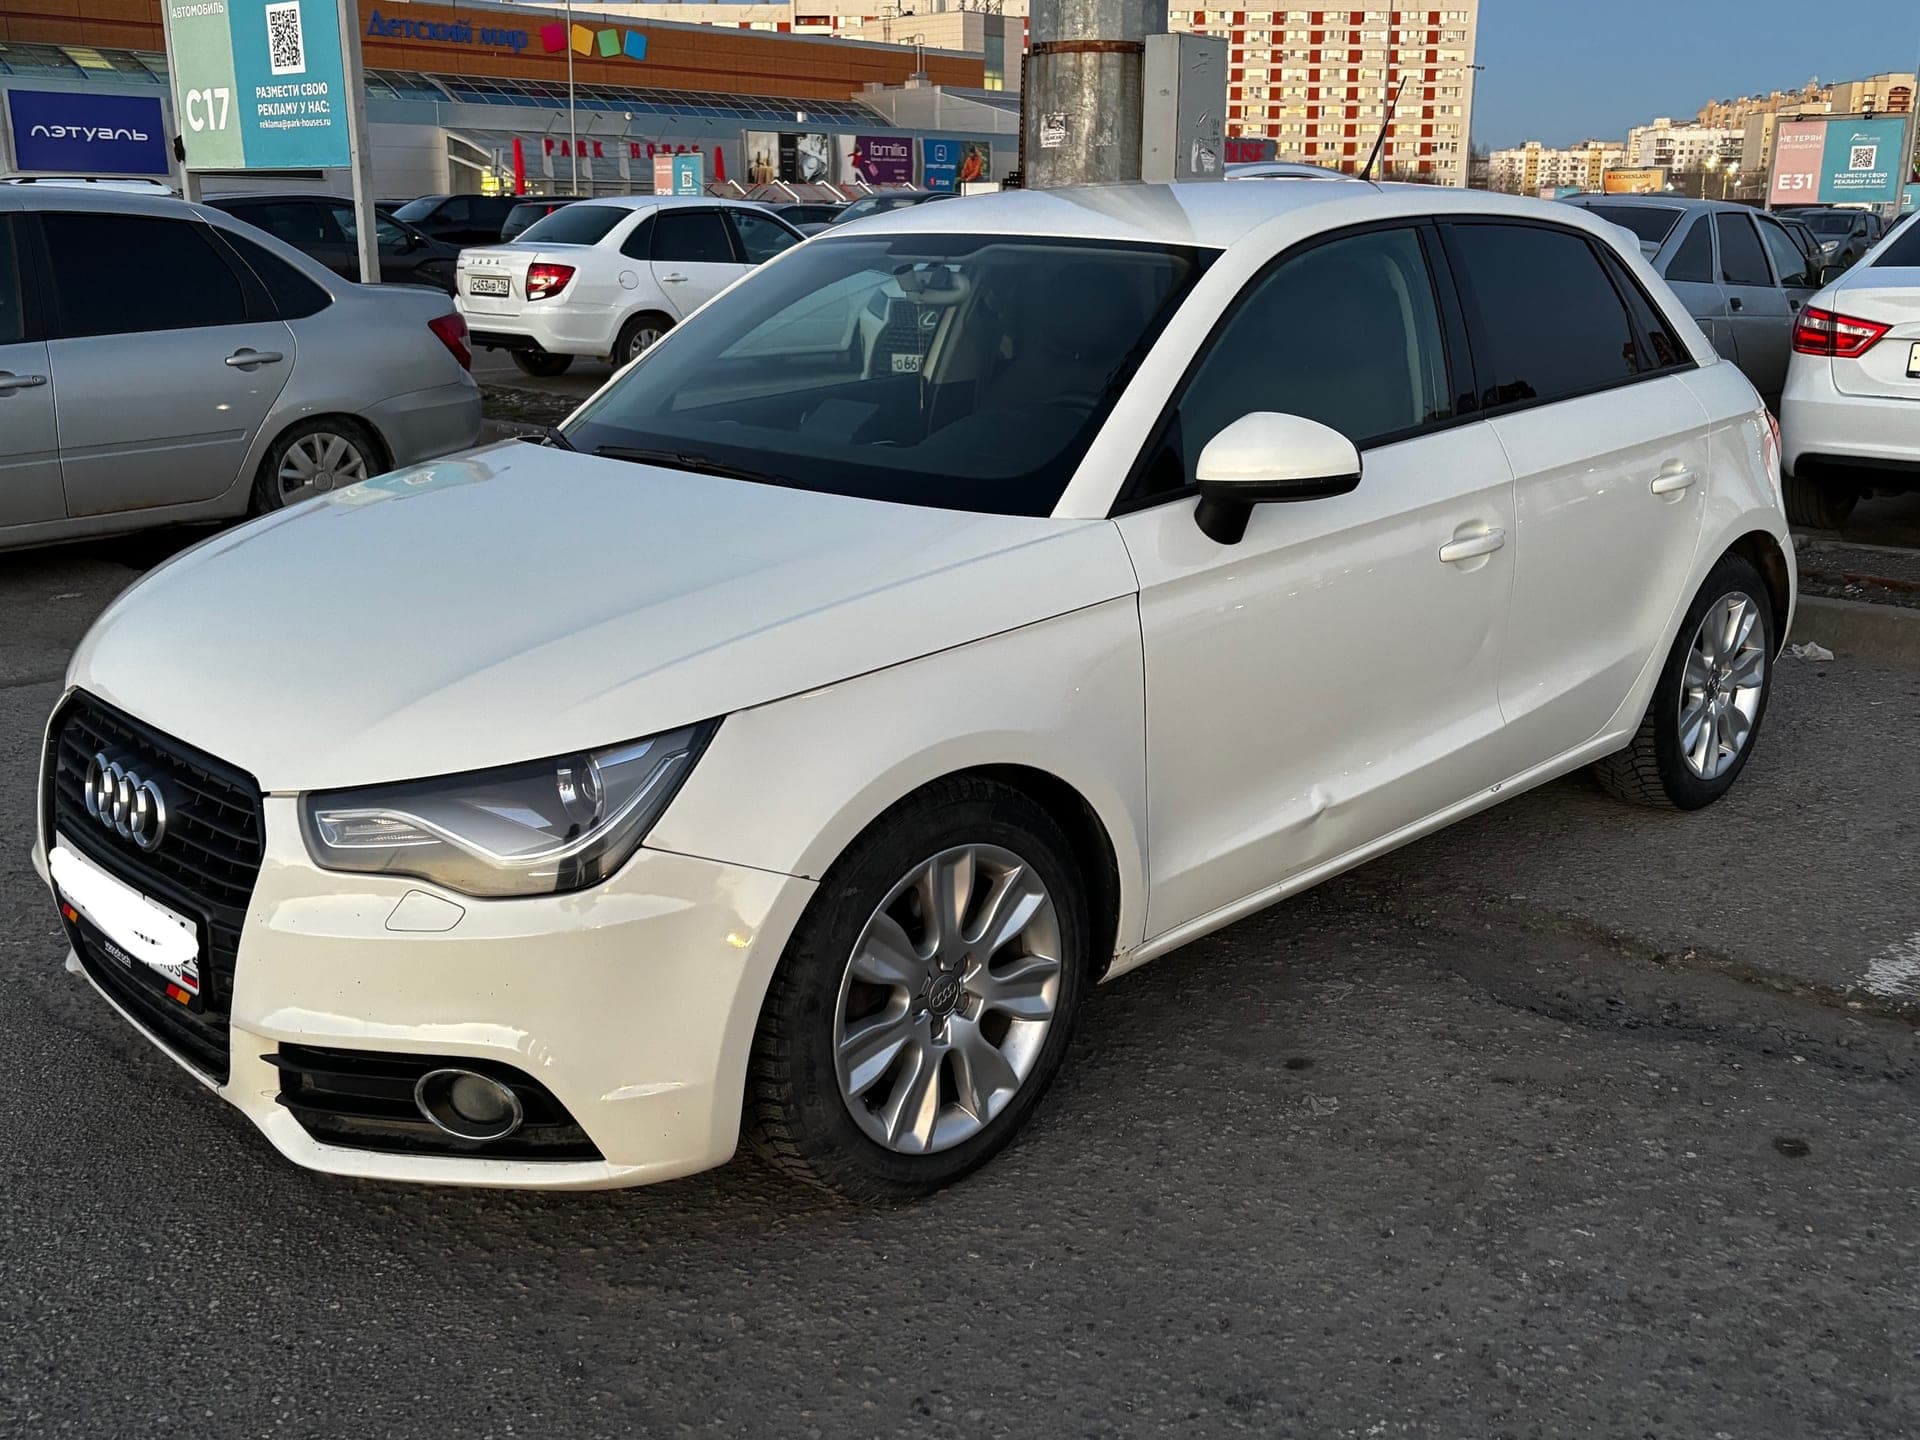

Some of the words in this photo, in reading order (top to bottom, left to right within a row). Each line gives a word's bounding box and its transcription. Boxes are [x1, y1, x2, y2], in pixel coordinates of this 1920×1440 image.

[171, 2, 224, 19] АВТОМОБИЛЬ
[367, 9, 472, 43] Детский
[479, 28, 528, 54] мир
[255, 84, 299, 99] РАЗМЕСТИ
[301, 82, 328, 96] СВОЮ
[186, 87, 230, 132] C17
[257, 101, 298, 116] РЕКЛАМУ
[300, 101, 306, 114] У
[308, 99, 330, 114] НАС:
[544, 138, 604, 158] PARK
[1777, 173, 1814, 190] E31
